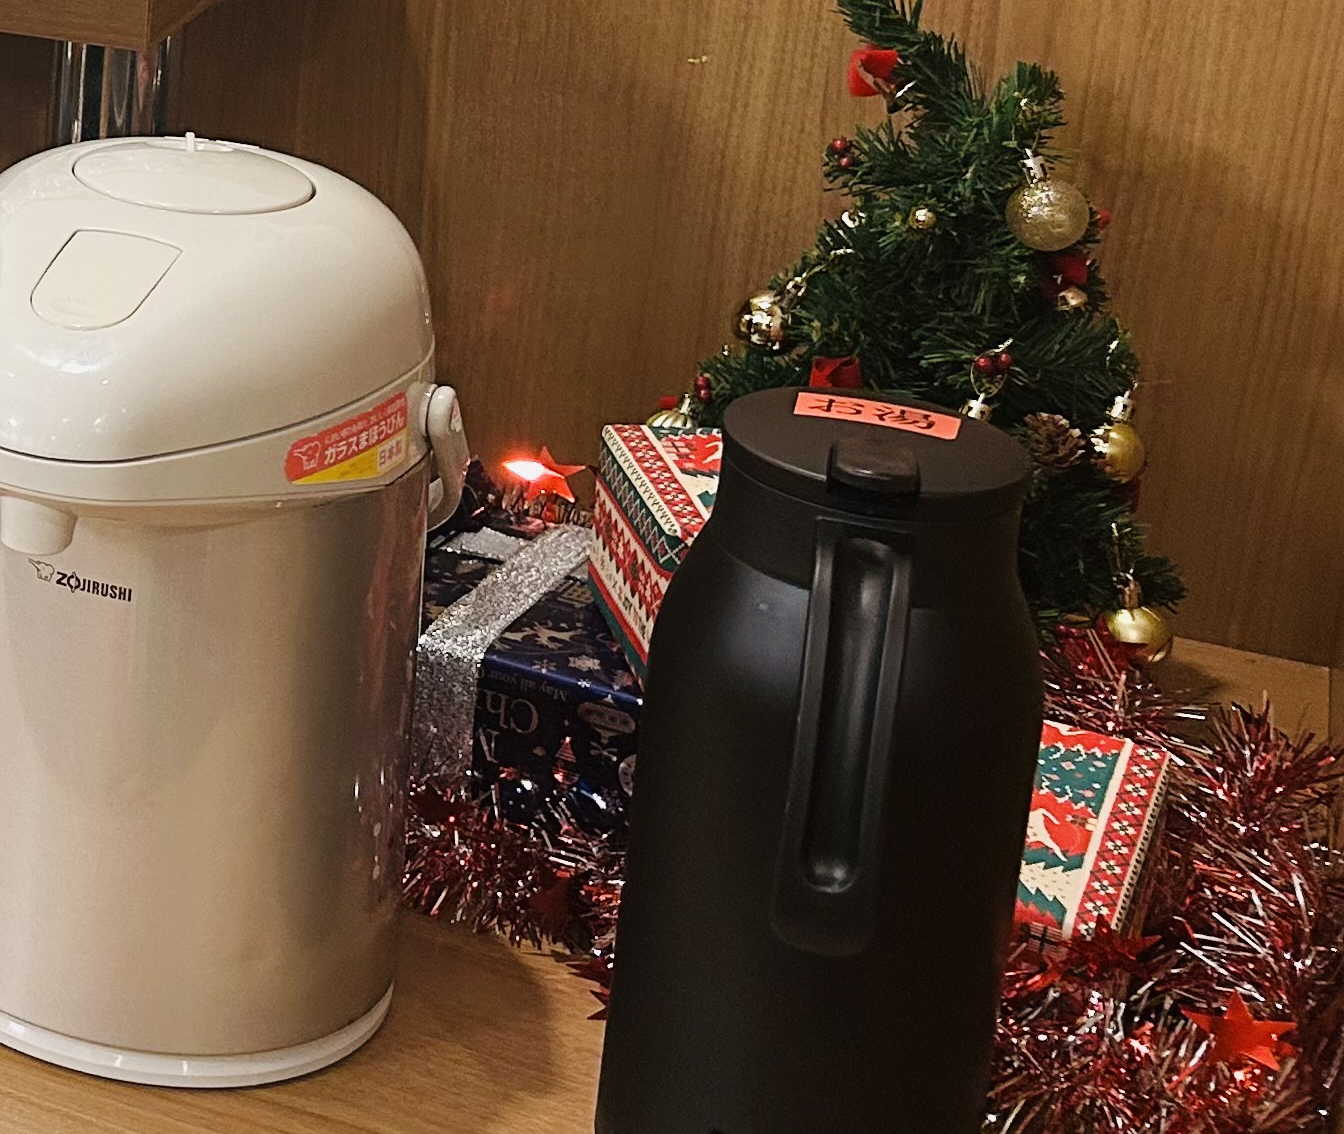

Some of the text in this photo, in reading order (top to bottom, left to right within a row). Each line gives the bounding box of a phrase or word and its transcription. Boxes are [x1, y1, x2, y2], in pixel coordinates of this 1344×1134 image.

[324, 411, 404, 466] ガラスまほうびん
[55, 571, 133, 602] ZOJIRUSHI
